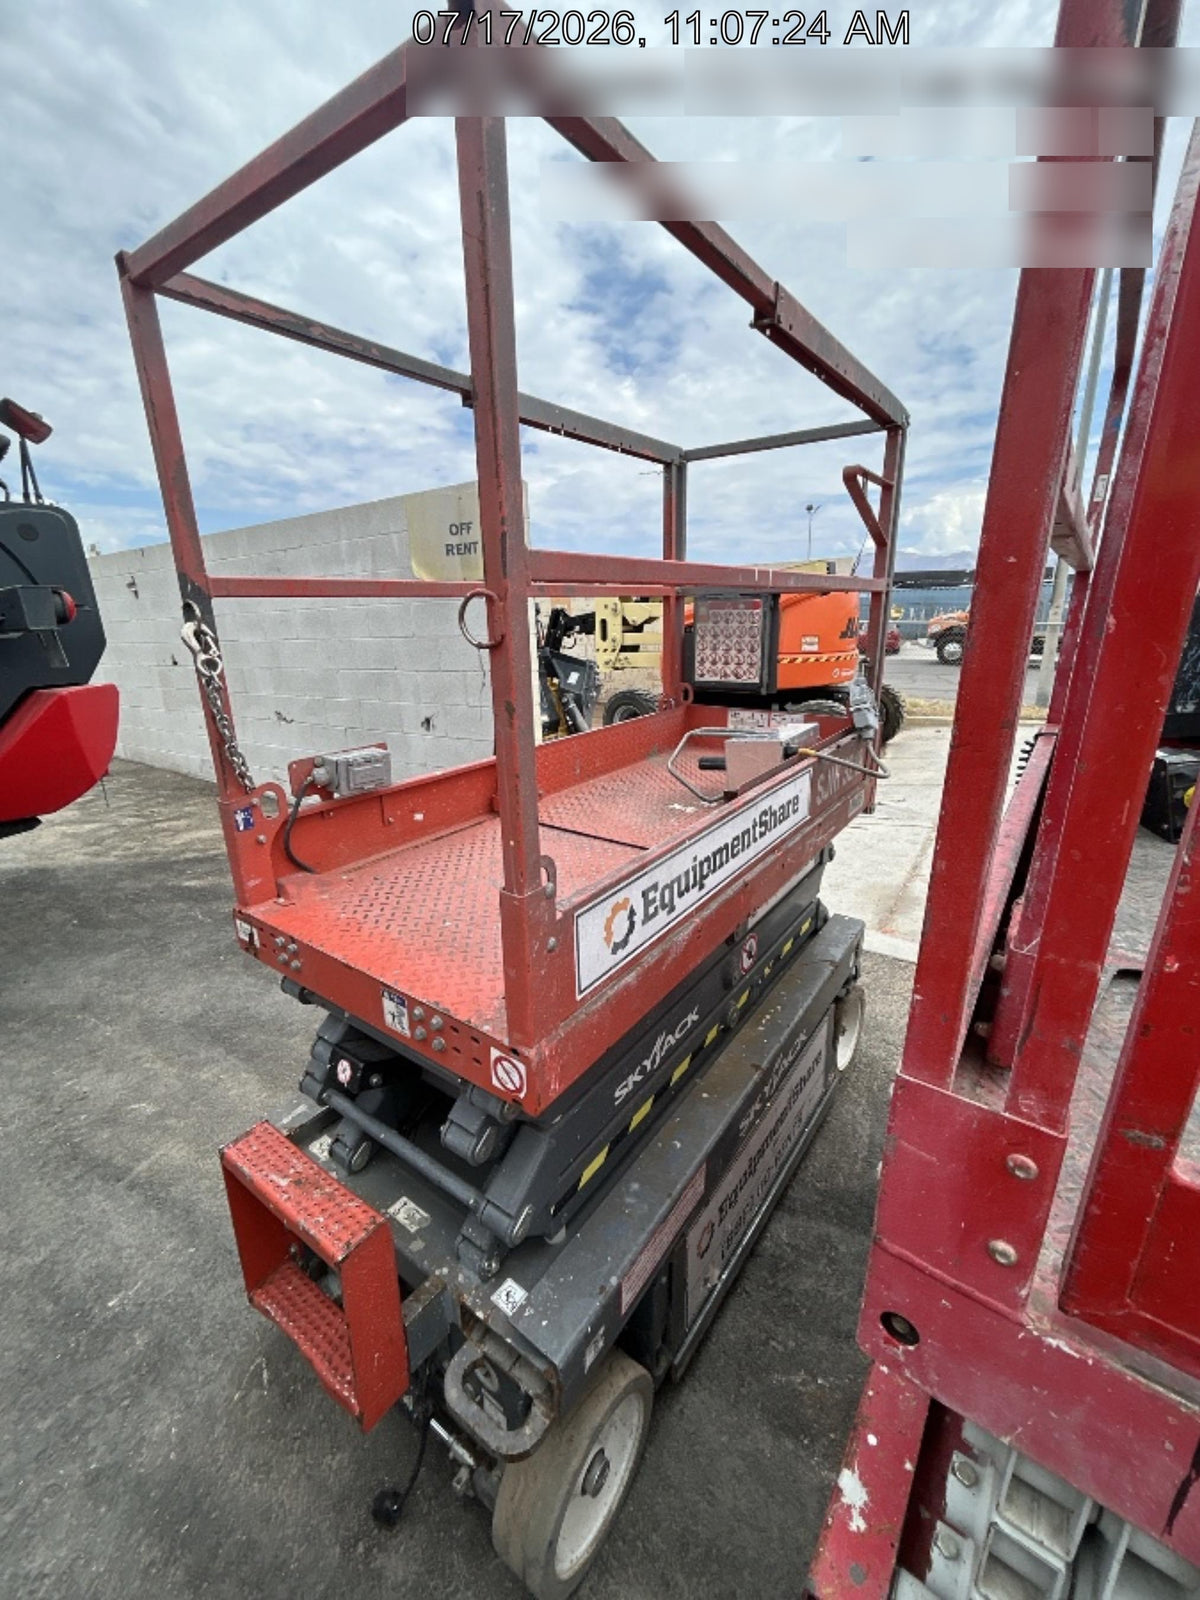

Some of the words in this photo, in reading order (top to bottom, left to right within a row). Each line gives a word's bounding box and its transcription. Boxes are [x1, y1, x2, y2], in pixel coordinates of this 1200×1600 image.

[445, 541, 479, 556] RENT
[448, 522, 473, 536] OFF
[640, 793, 800, 926] EquipmentShare
[614, 1004, 699, 1106] SKYJACK
